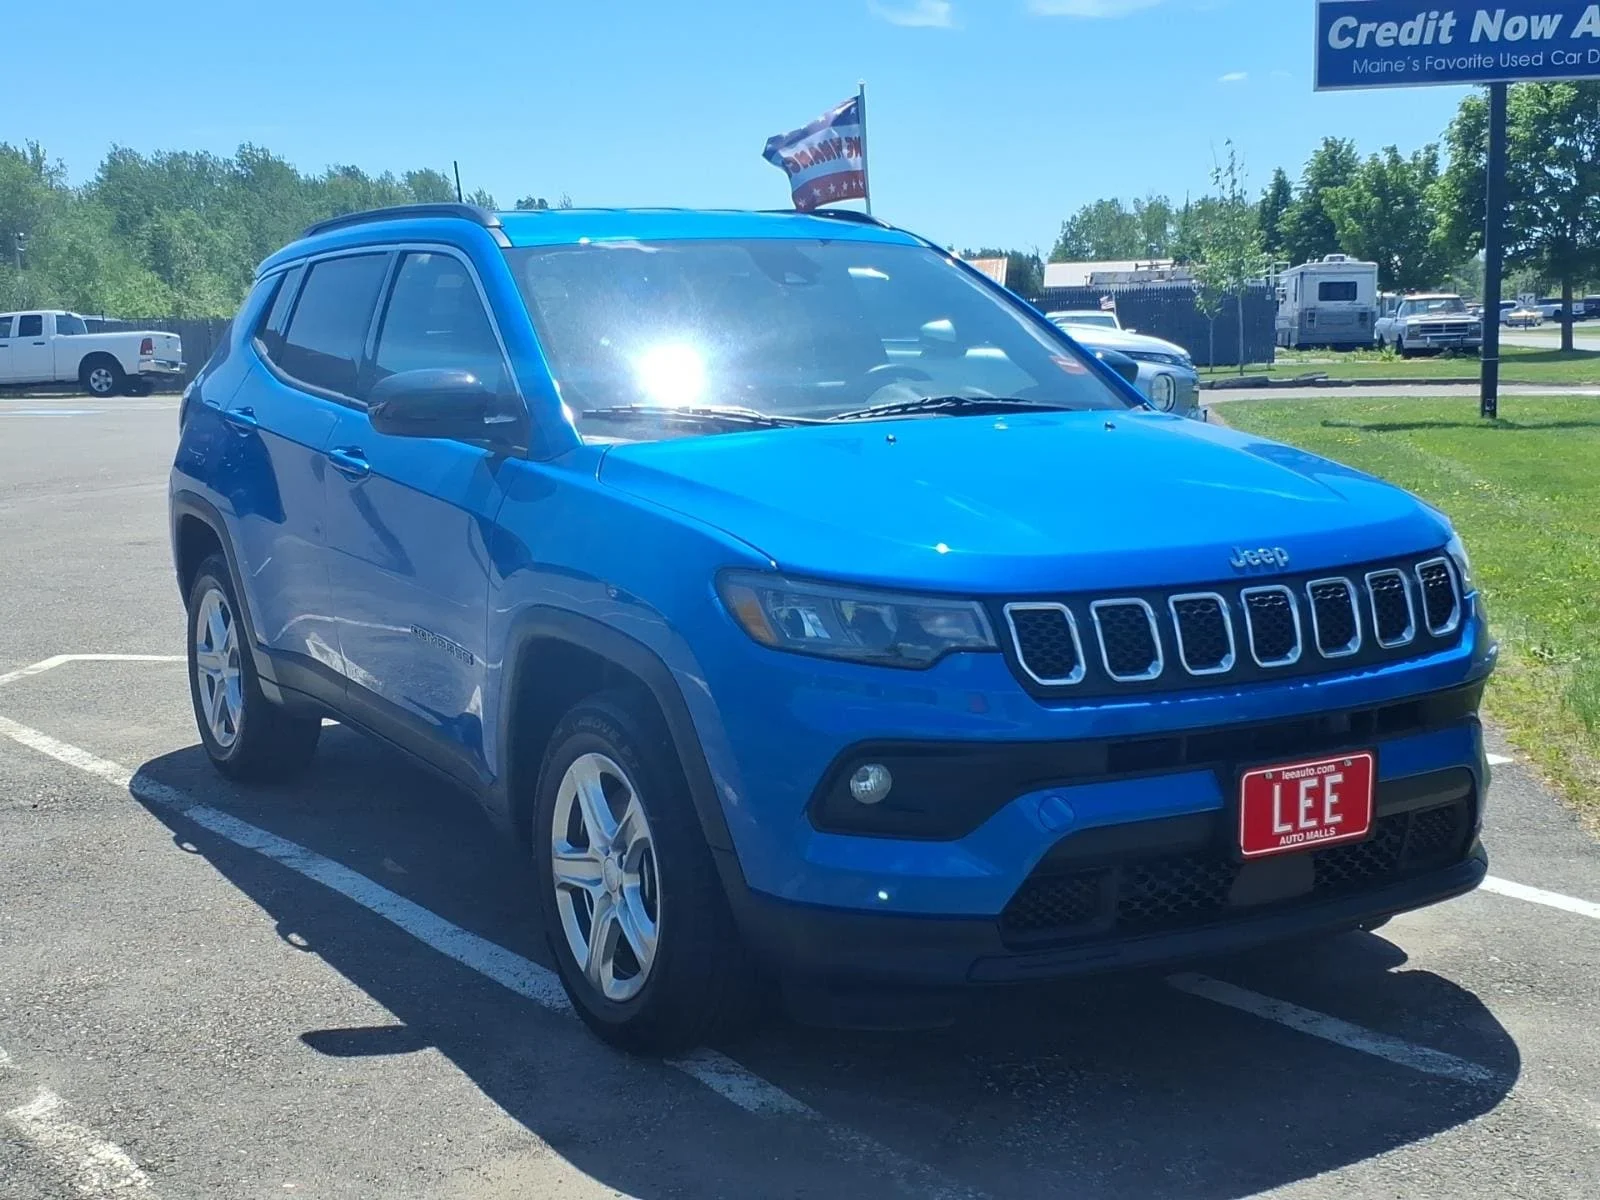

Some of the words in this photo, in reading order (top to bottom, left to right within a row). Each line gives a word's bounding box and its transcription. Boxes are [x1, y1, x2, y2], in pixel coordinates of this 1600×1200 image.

[1328, 10, 1457, 49] Credit
[1469, 9, 1563, 43] Now
[1353, 55, 1420, 74] Maine's
[1425, 54, 1494, 71] Favorite
[1499, 52, 1543, 68] Used
[1550, 51, 1582, 65] Car
[1230, 546, 1289, 568] Jeep
[1282, 764, 1336, 780] leeauto.com
[1273, 774, 1343, 834] LEE
[1279, 833, 1305, 846] AUTO
[1306, 826, 1336, 841] MALLS
